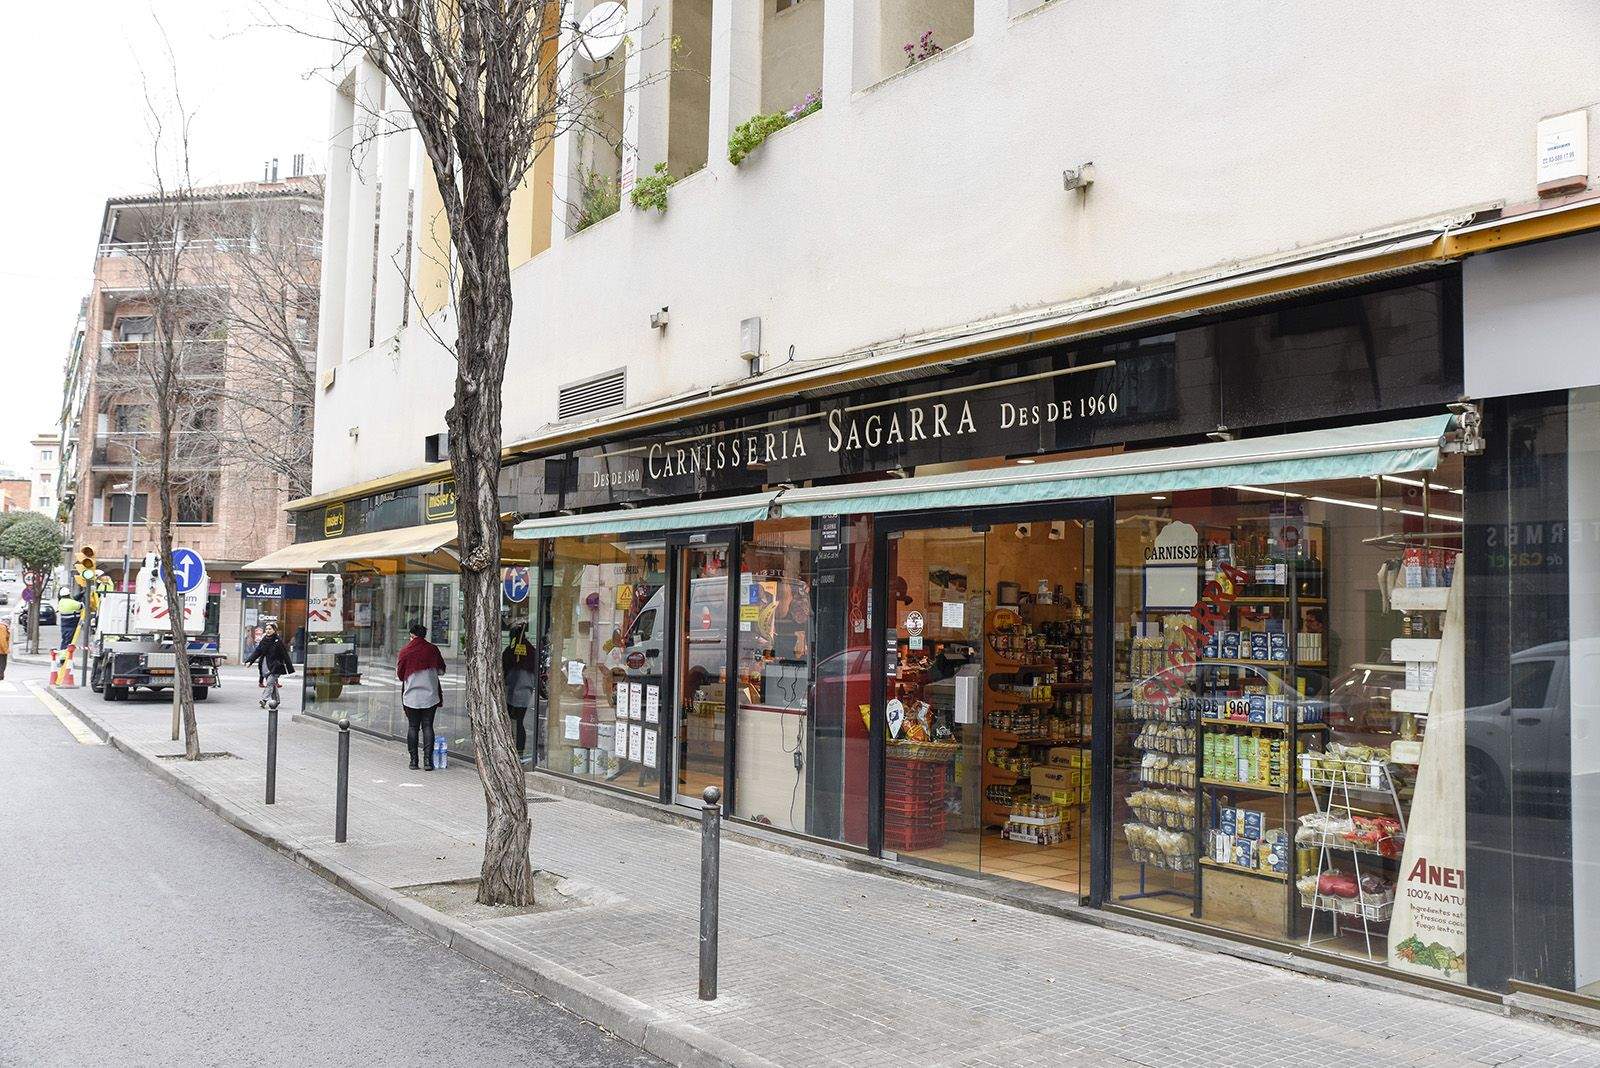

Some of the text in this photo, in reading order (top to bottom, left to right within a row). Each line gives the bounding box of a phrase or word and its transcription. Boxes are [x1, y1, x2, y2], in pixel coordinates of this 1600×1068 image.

[1080, 393, 1118, 418] 1960
[649, 399, 976, 480] CARNISSERIA SAGARRA
[624, 469, 640, 483] 1960
[1144, 545, 1219, 561] CARNISSERIA
[258, 584, 282, 596] Aural
[1143, 562, 1250, 713] SAGARRA
[1181, 698, 1250, 716] DESDE 1960
[1407, 888, 1464, 906] 100% NATU
[1410, 903, 1451, 917] Ingredientes
[1416, 920, 1436, 932] fuego
[1437, 924, 1455, 934] lento
[1420, 914, 1446, 925] frescos
